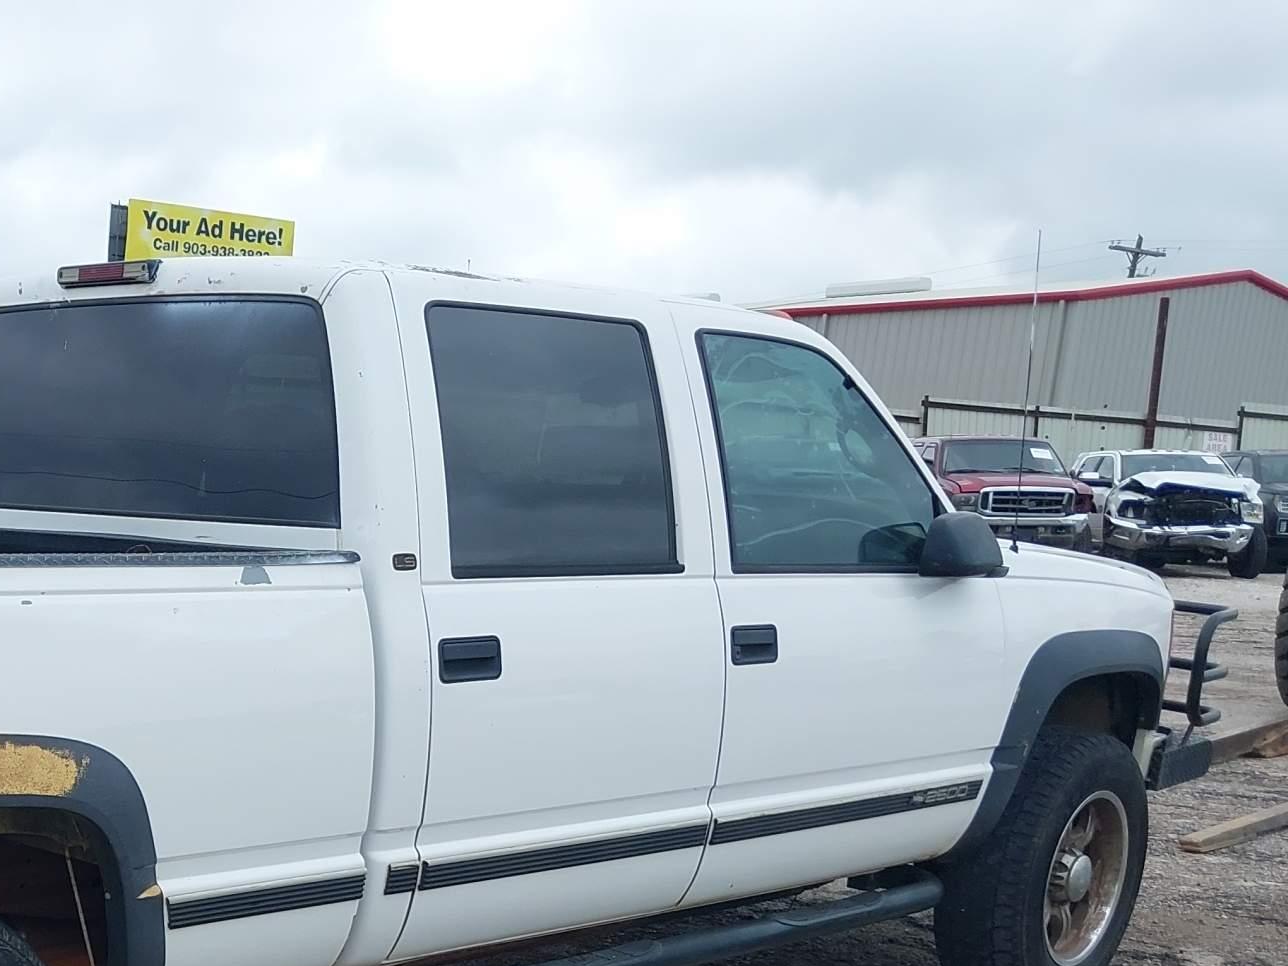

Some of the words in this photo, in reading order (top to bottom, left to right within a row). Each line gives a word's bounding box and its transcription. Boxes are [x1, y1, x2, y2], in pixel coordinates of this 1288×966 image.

[143, 210, 190, 234] Your
[196, 217, 223, 239] Ad
[230, 221, 283, 247] Here!
[153, 238, 179, 253] Call
[1208, 432, 1227, 441] SALE
[394, 556, 416, 568] LS
